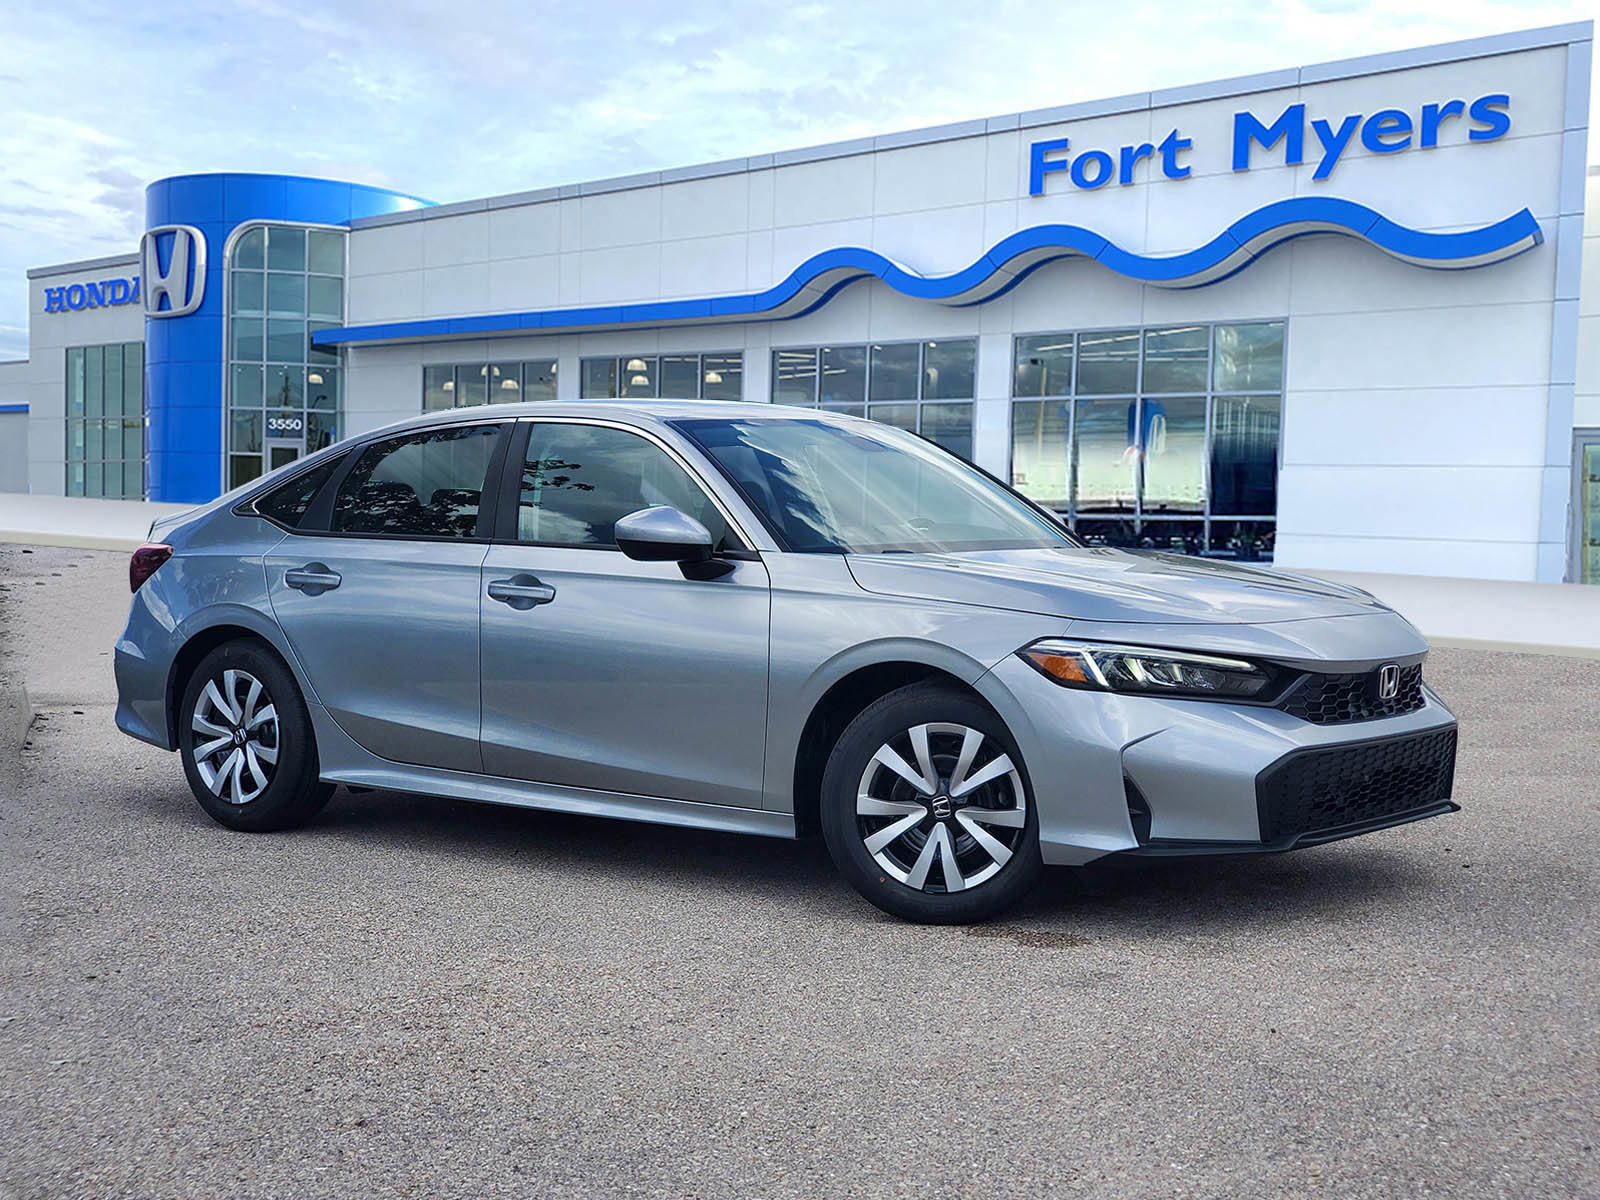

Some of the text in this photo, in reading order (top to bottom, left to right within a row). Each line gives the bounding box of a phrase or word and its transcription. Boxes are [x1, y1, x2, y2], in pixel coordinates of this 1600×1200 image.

[1029, 93, 1511, 197] Fort Myers
[268, 418, 302, 430] 3550
